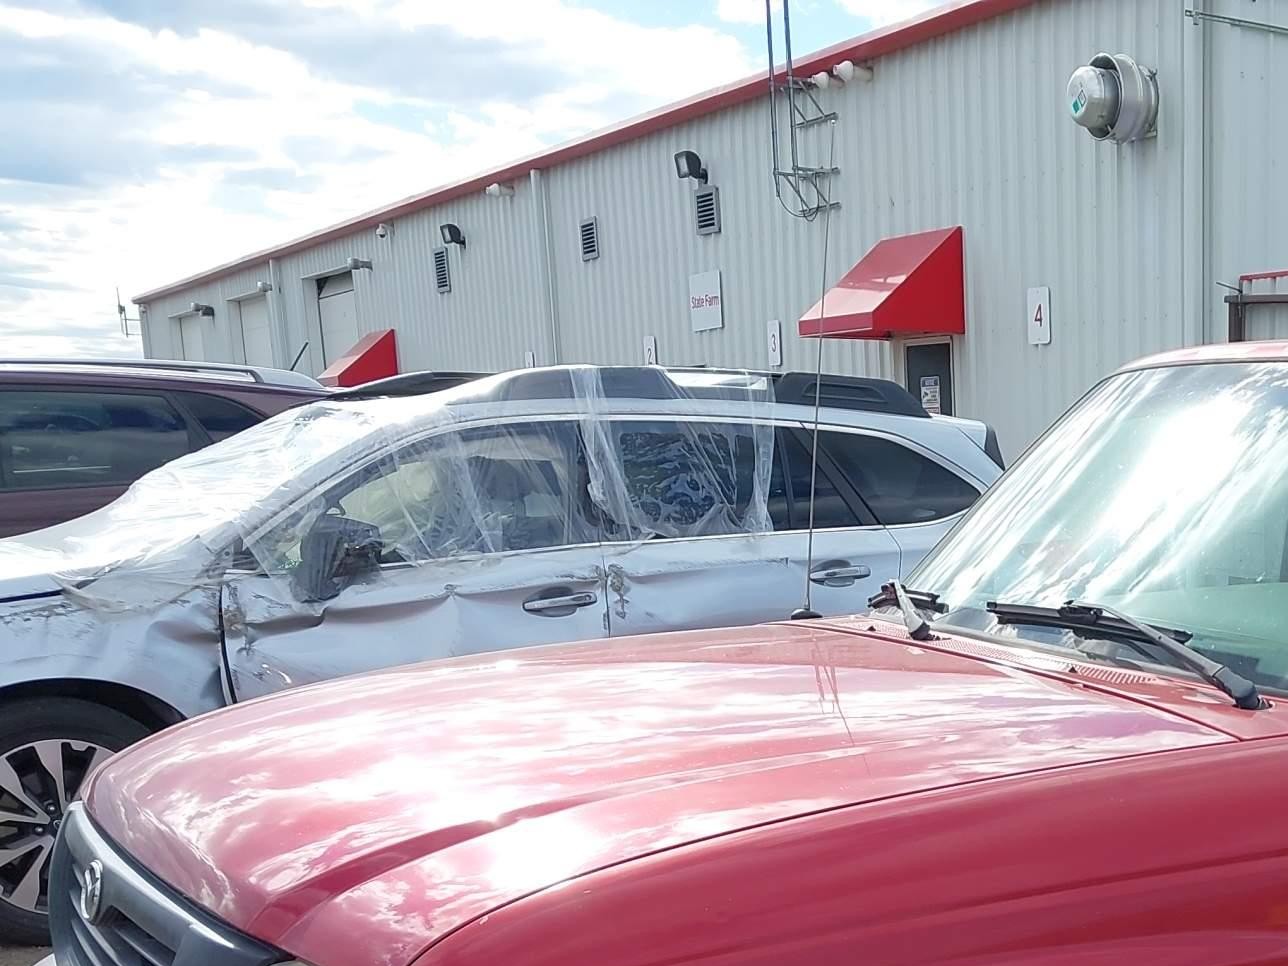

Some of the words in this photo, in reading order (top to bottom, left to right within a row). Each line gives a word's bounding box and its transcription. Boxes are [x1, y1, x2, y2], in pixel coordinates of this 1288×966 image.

[691, 296, 704, 309] State
[704, 294, 720, 306] Farm
[1034, 303, 1043, 327] 4
[771, 334, 776, 352] 3
[647, 348, 653, 365] 2
